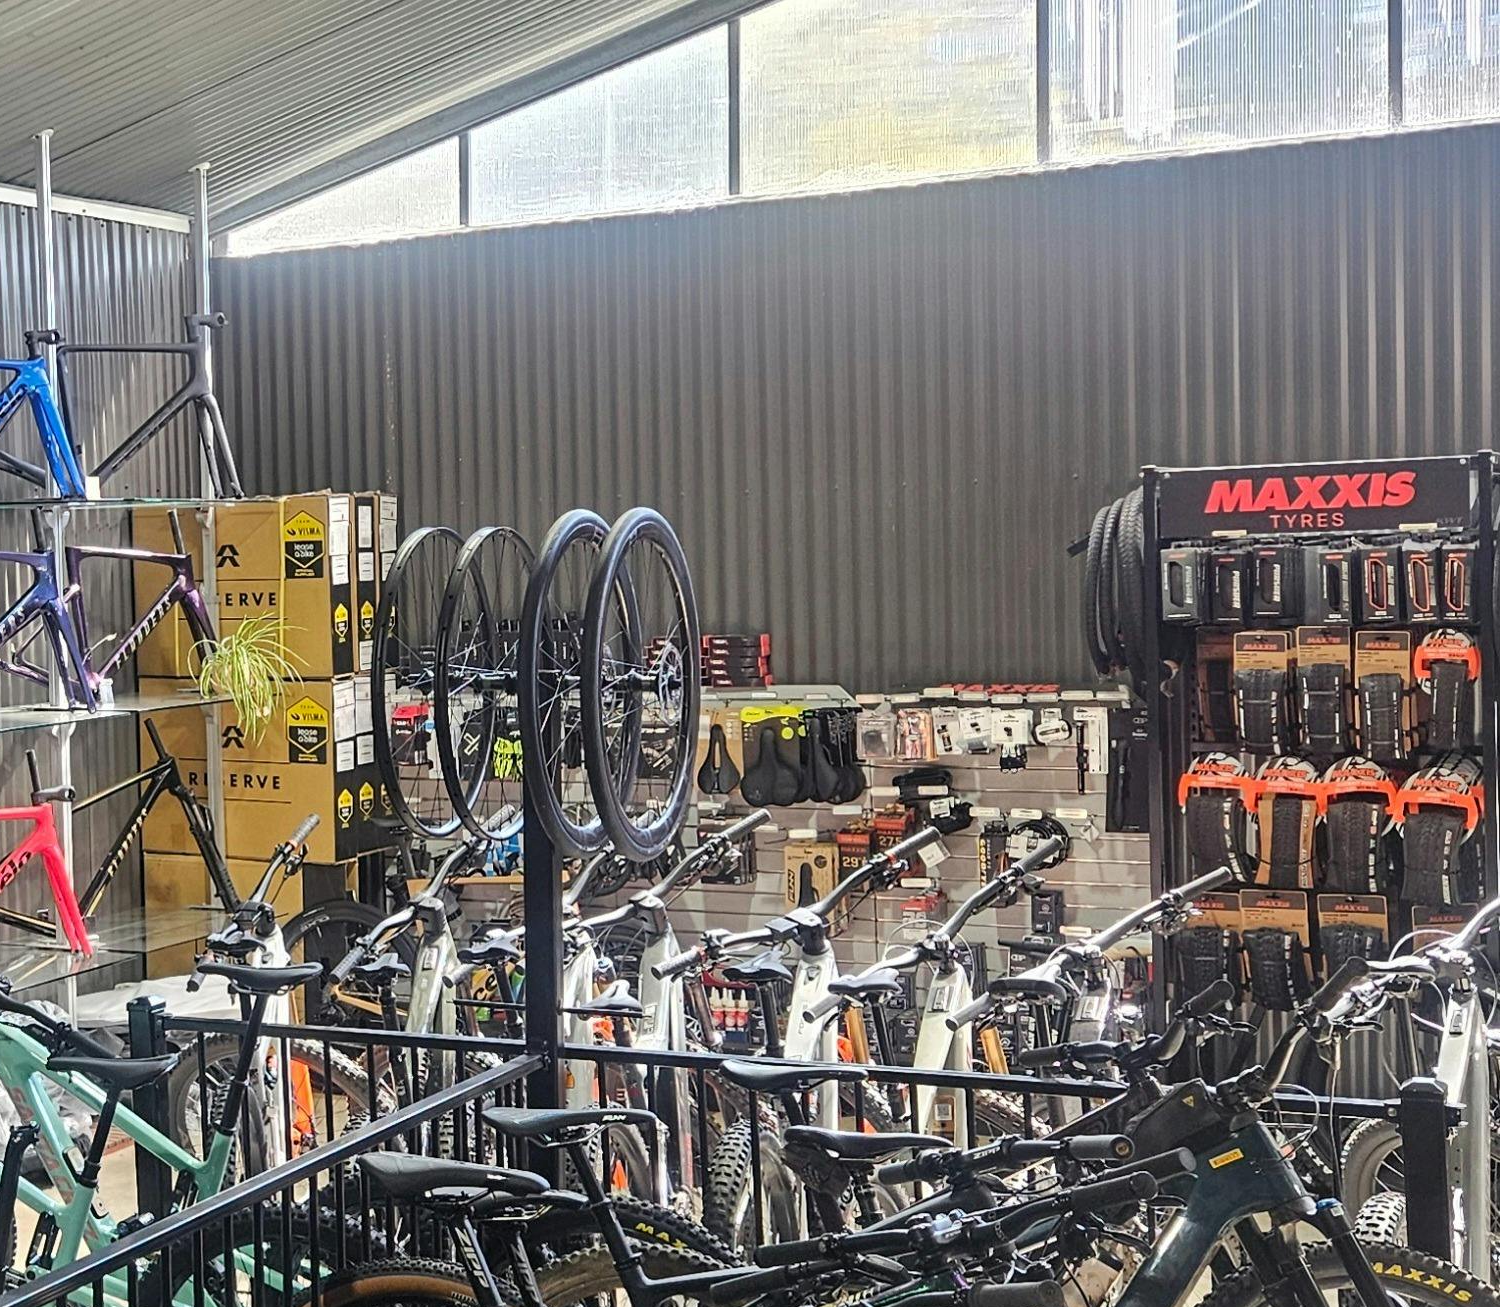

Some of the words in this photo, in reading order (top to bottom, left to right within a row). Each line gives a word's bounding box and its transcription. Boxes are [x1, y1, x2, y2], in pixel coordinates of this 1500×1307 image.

[1204, 472, 1416, 514] MAXXIS
[1270, 512, 1345, 529] TYRES
[225, 592, 277, 606] ERVE
[189, 773, 281, 790] RERVE
[1256, 899, 1290, 908] MAXXIS
[1335, 904, 1370, 912] MAXXIS
[454, 1226, 490, 1288] ZIPP
